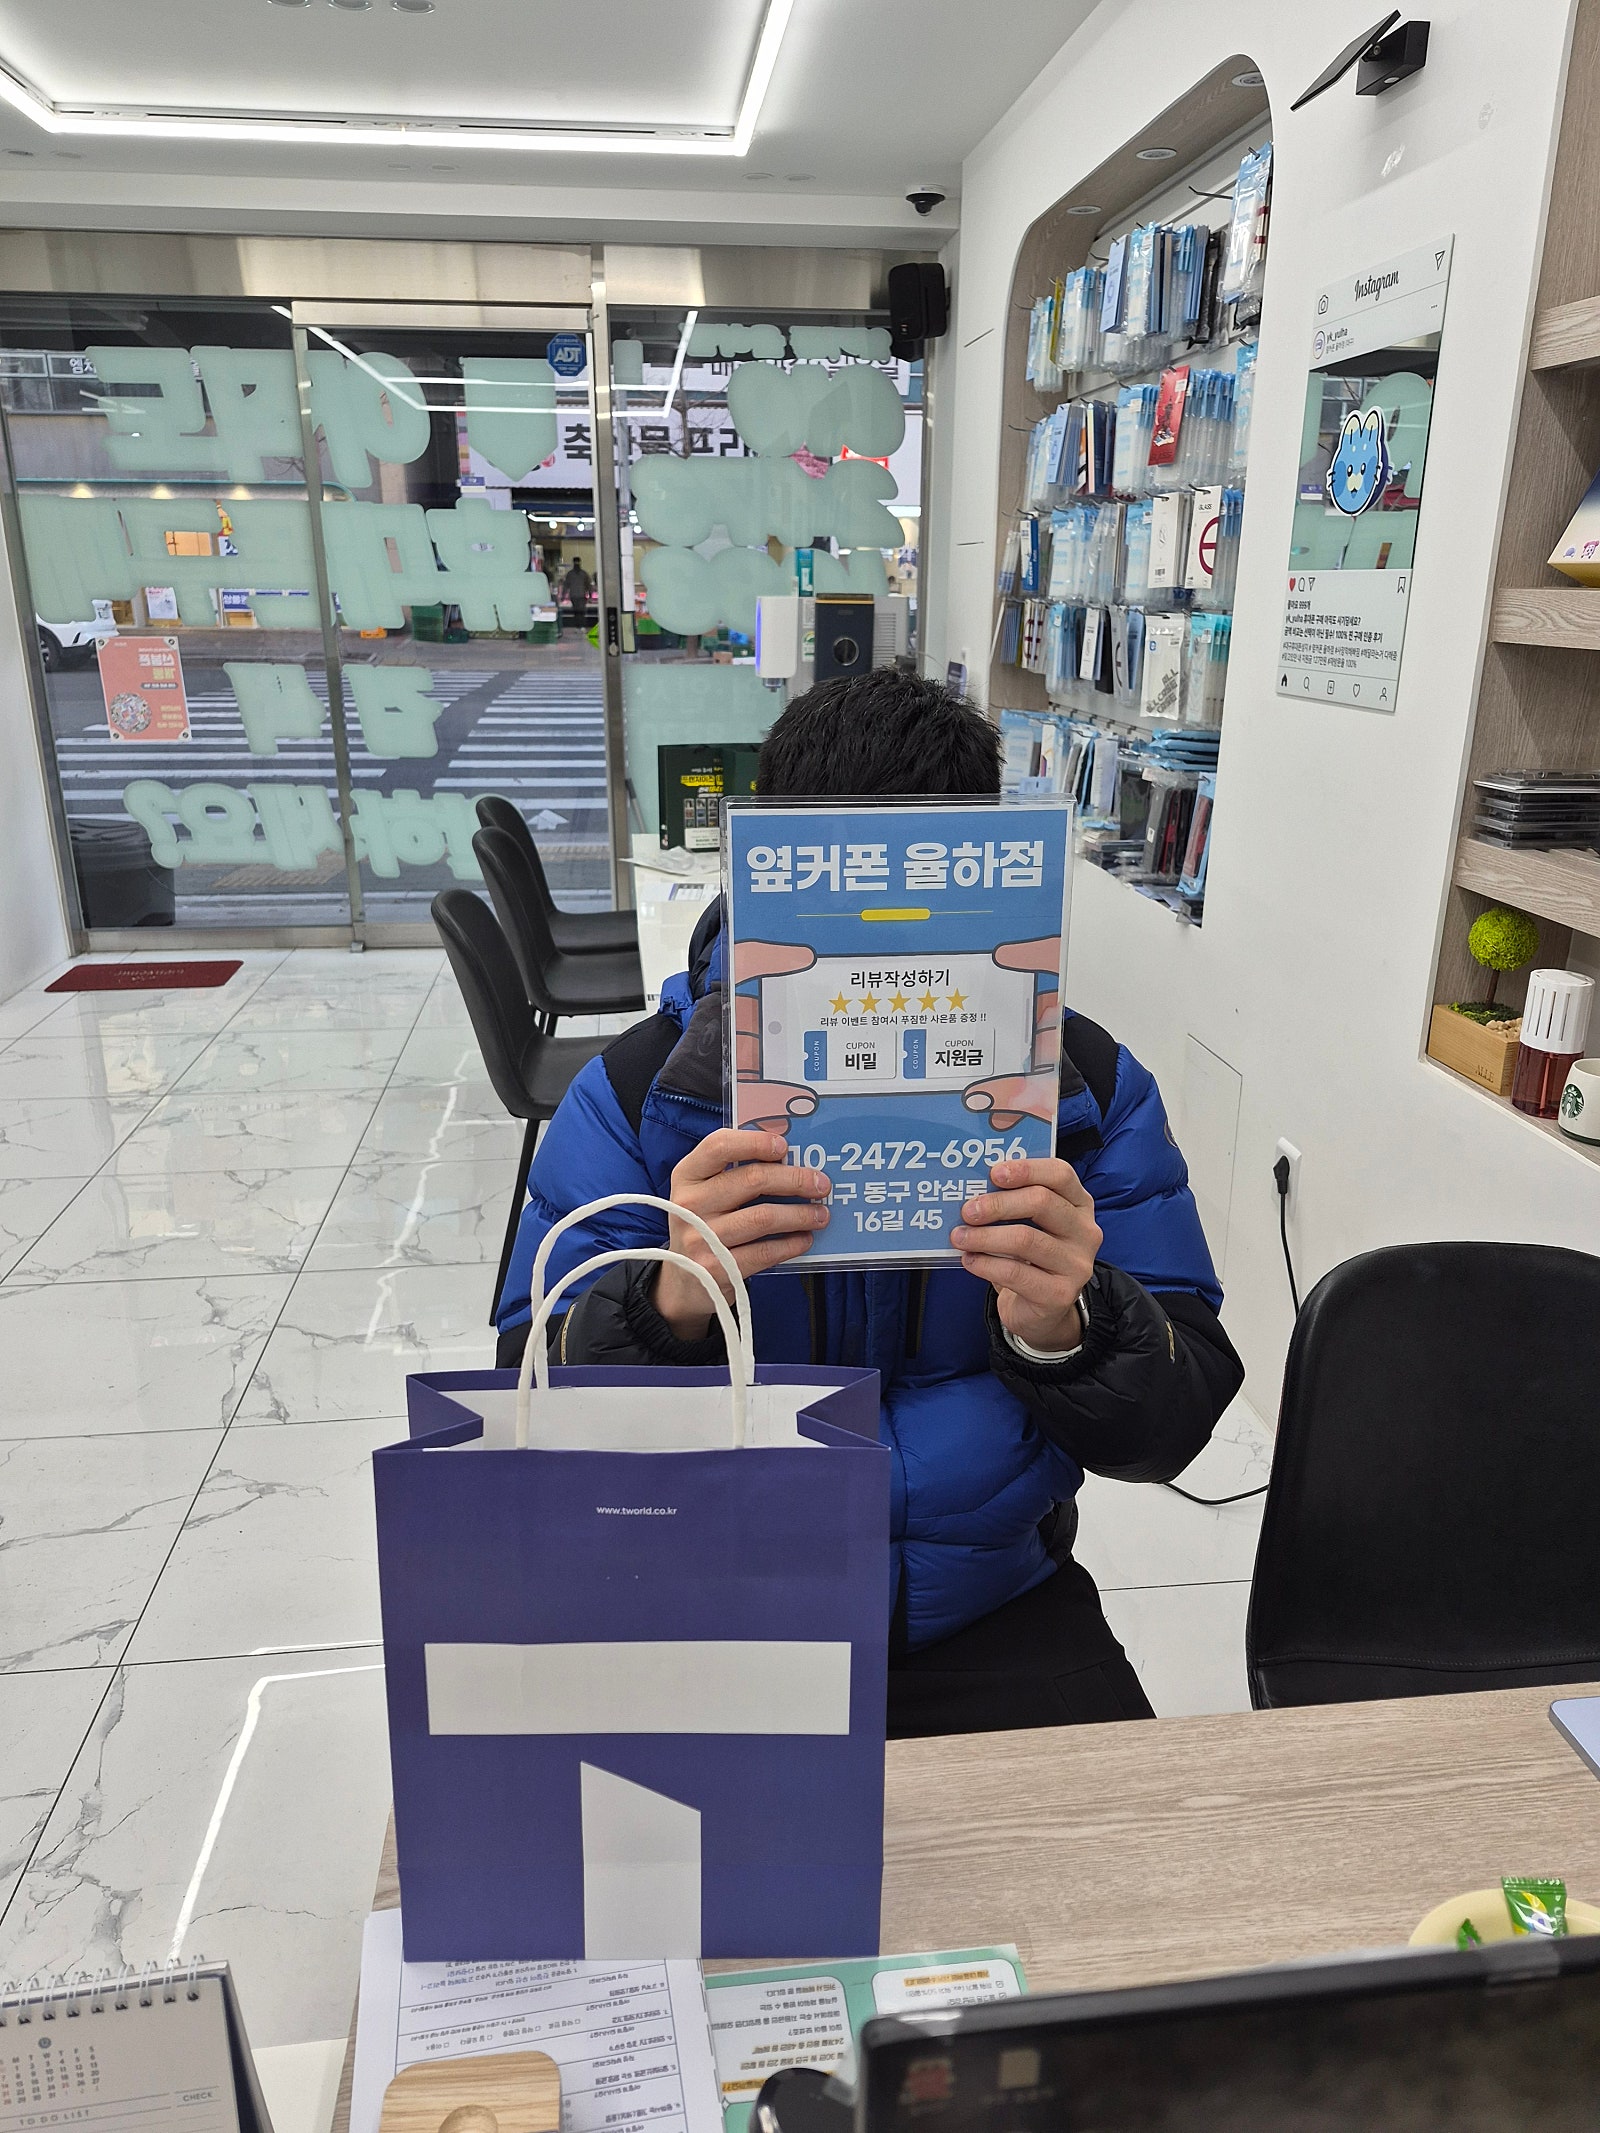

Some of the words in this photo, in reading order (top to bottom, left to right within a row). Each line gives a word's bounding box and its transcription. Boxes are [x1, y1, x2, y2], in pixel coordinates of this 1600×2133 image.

[1355, 271, 1399, 301] Instagram
[554, 347, 581, 363] ADT
[745, 843, 890, 894] 옆커폰
[904, 841, 1044, 890] 율하점
[851, 969, 950, 989] 리뷰작성하기
[820, 1016, 838, 1026] 리뷰
[842, 1016, 868, 1026] 이벤트
[871, 1015, 898, 1026] 참여시
[901, 1015, 927, 1025] 푸짐한
[931, 1014, 956, 1024] 사은품
[960, 1013, 977, 1023] 증정
[846, 1042, 875, 1050] CUPON
[845, 1053, 877, 1070] 비밀
[935, 1049, 983, 1067] 지원금
[782, 1137, 1027, 1171] 10-2472-6956
[864, 1181, 910, 1204] 동구
[917, 1179, 988, 1202] 안심로
[854, 1209, 904, 1232] 16길
[910, 1209, 943, 1230] 45
[596, 1507, 677, 1515] www.tworld.co.kr
[183, 2092, 213, 2102] CHECK
